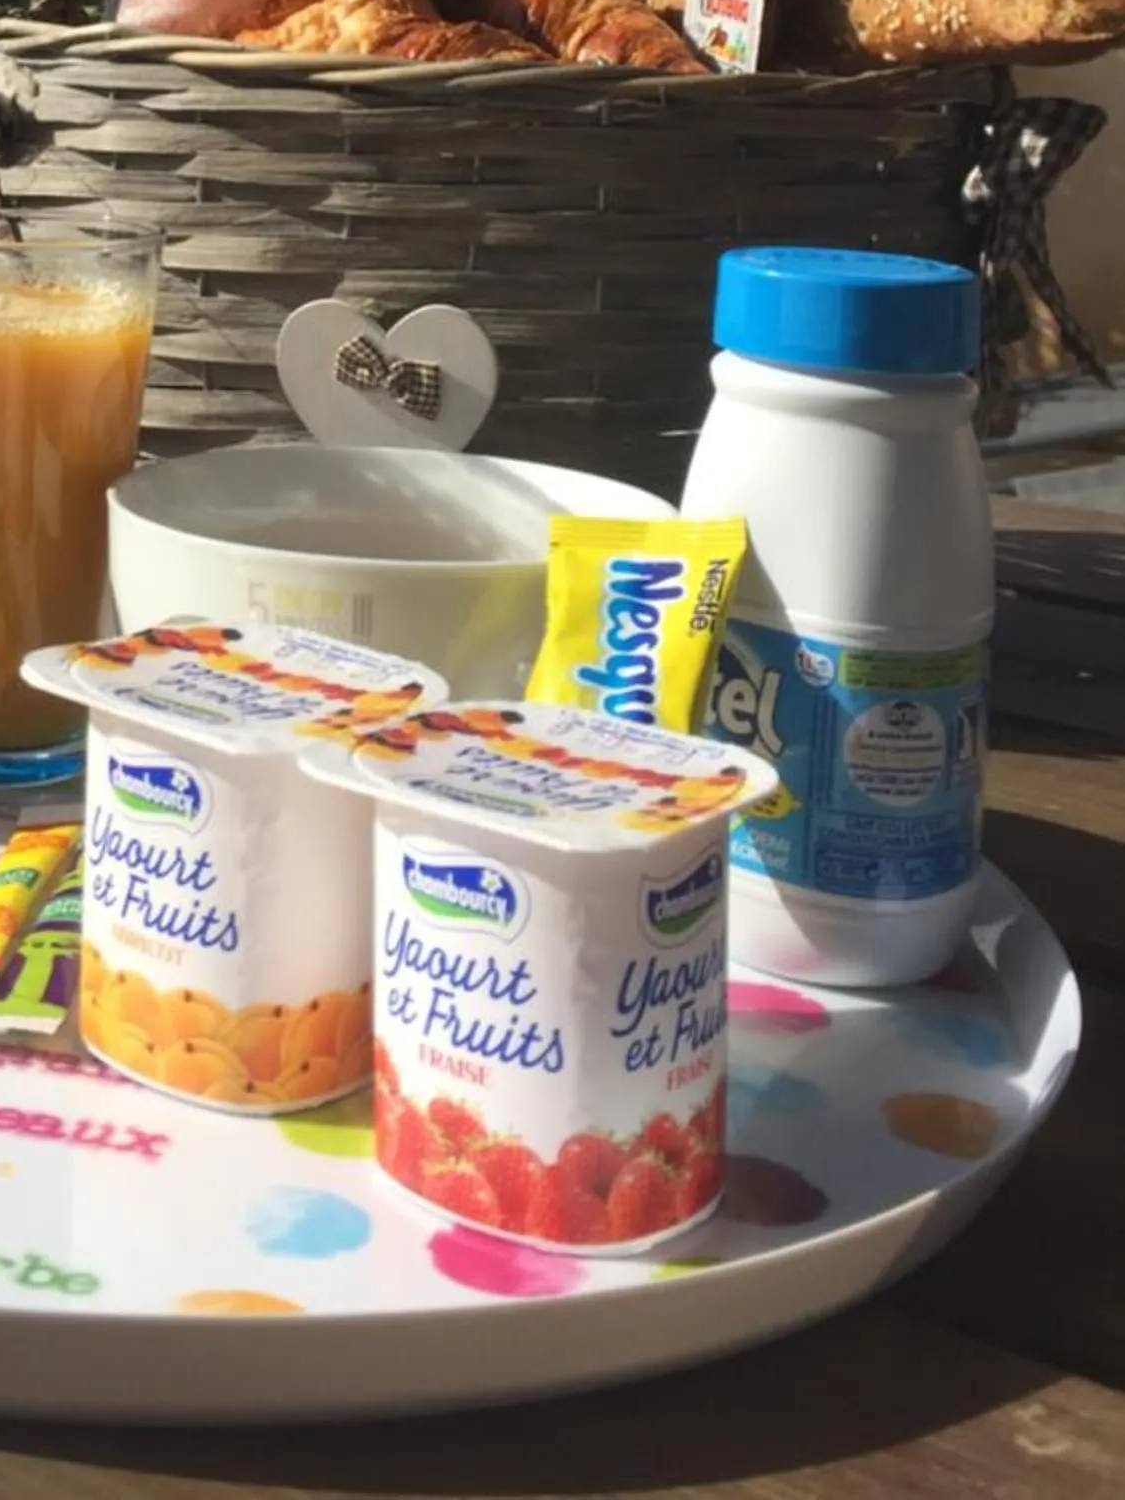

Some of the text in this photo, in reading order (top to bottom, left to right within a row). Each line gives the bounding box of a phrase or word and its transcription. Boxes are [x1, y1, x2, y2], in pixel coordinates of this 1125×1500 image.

[577, 558, 684, 725] Nesqu
[89, 804, 217, 892] Yaourt
[92, 872, 239, 953] et Fruits
[382, 909, 539, 1006] Yaourt
[610, 935, 726, 1038] Yaour
[387, 985, 565, 1075] et Fruits
[417, 1041, 493, 1088] FRAISE
[625, 1022, 666, 1074] et
